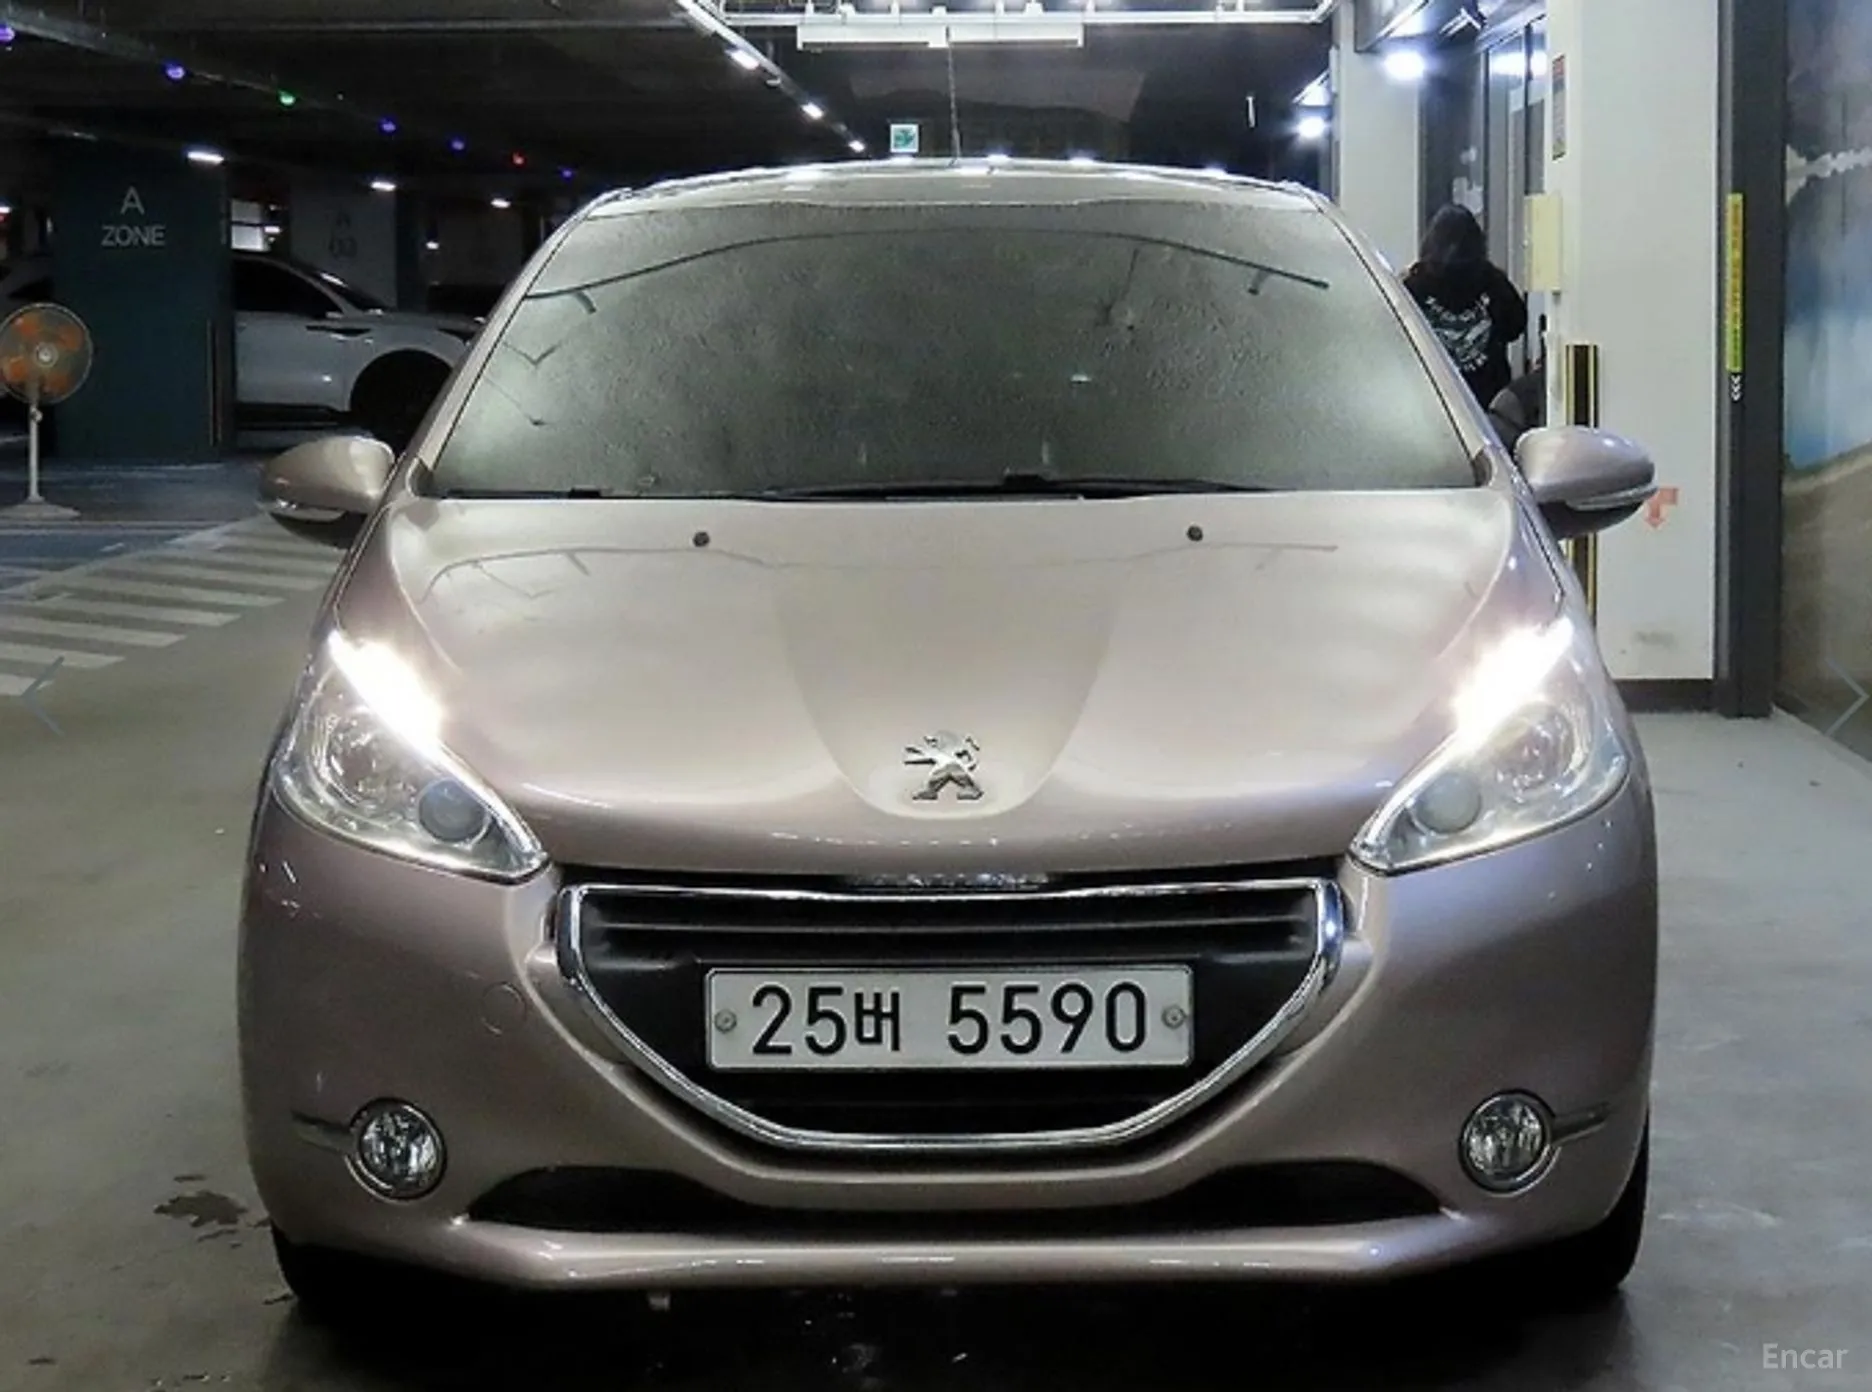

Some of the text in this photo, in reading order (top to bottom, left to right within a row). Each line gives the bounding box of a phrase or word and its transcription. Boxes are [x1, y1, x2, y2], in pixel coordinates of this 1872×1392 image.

[121, 186, 145, 215] A
[101, 225, 166, 246] ZONE
[752, 982, 1146, 1056] 25버 5590
